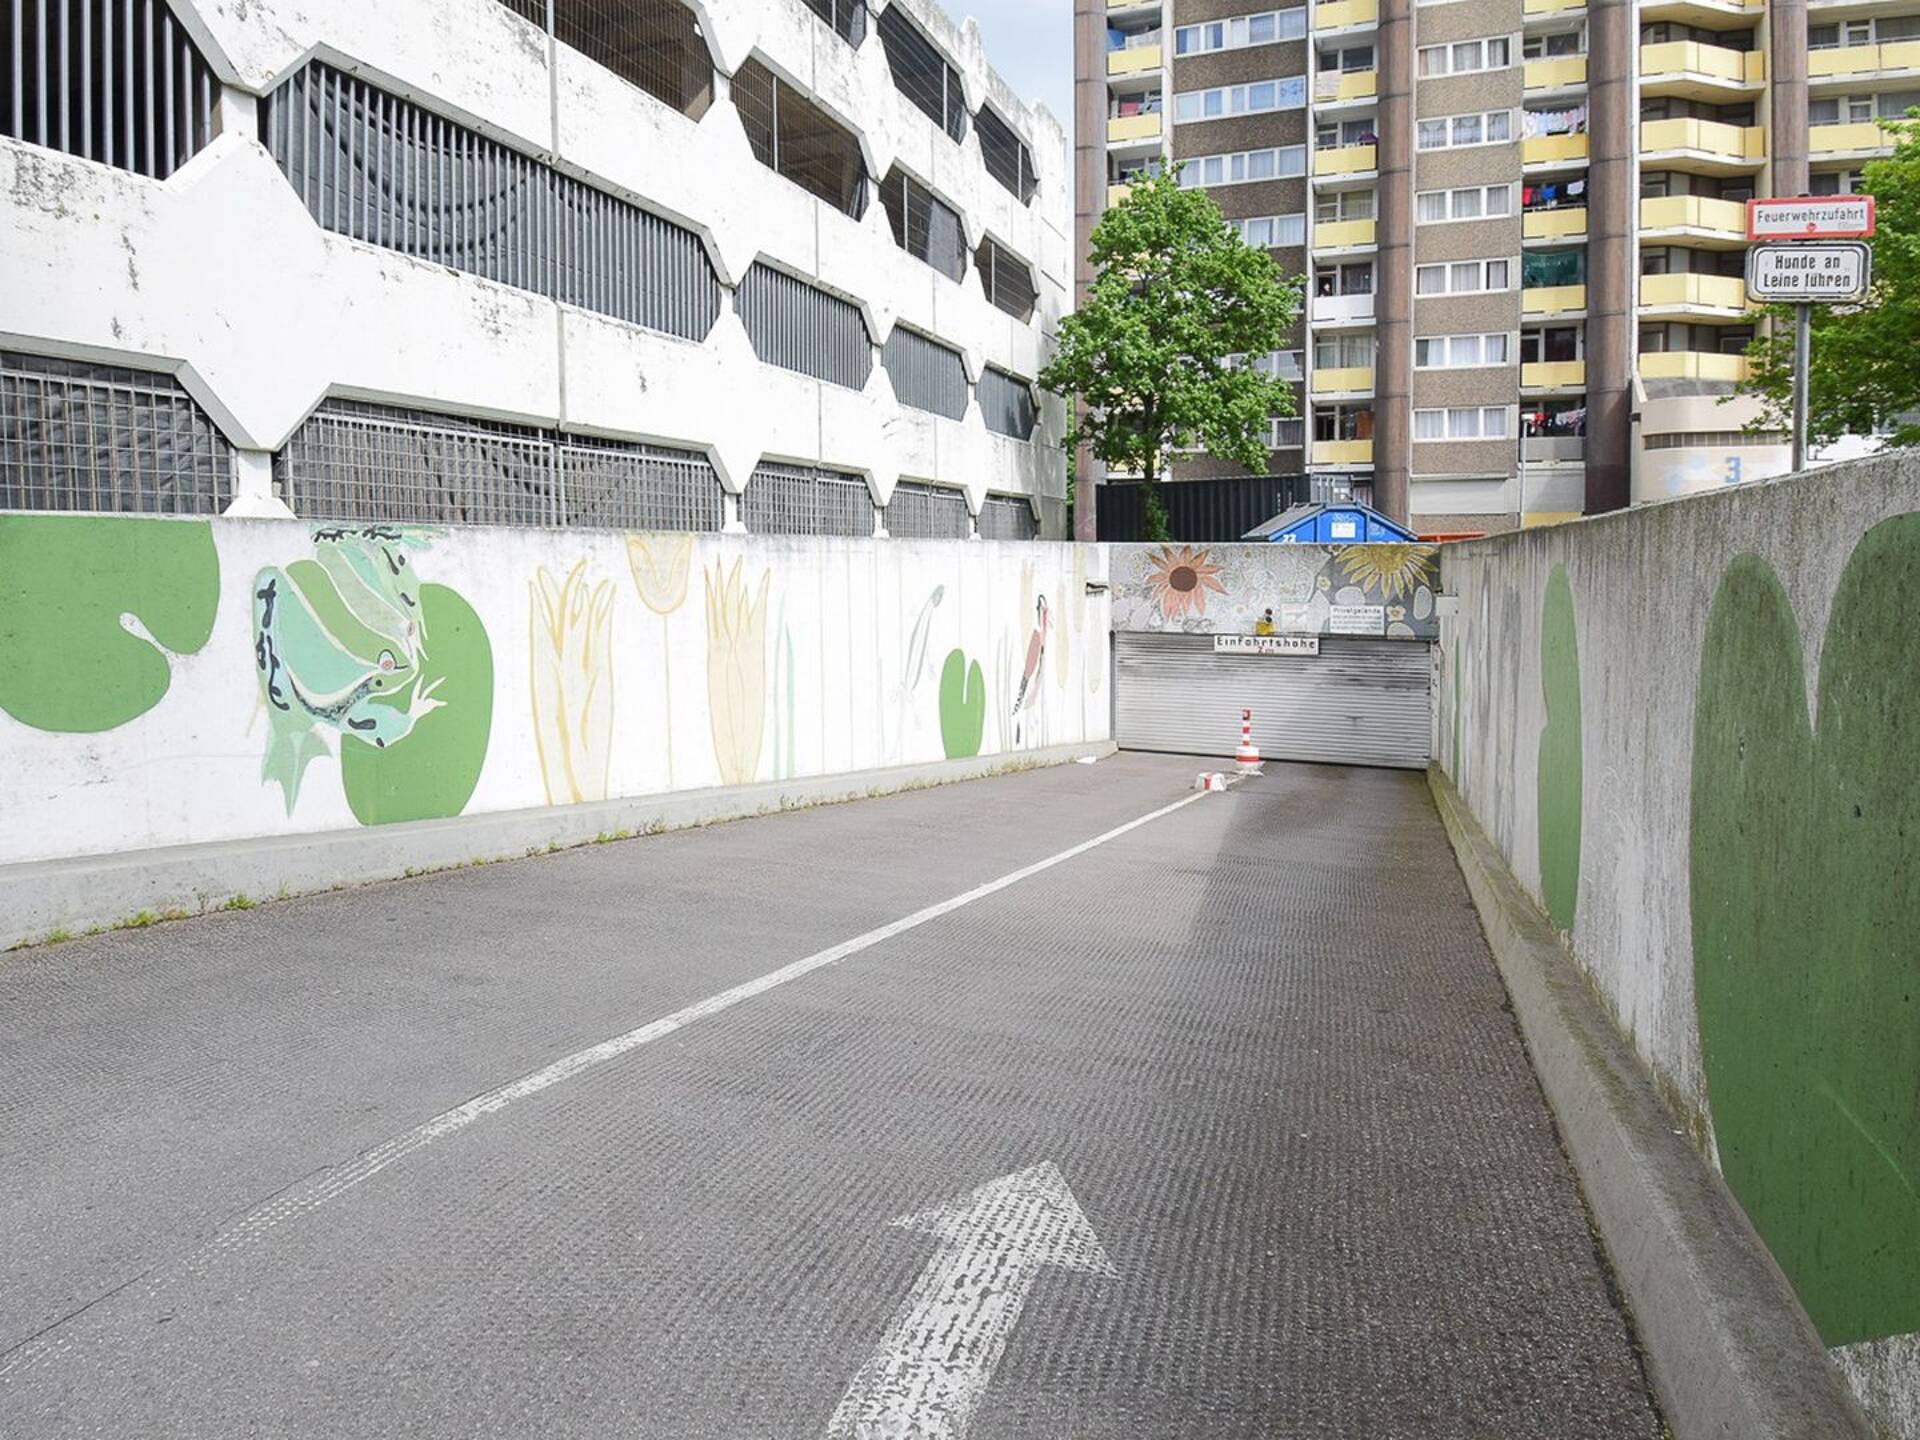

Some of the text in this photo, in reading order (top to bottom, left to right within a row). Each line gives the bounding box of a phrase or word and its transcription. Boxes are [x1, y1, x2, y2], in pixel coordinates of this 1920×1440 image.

[1757, 208, 1865, 223] Feuerwehrzufahrt
[1775, 255, 1840, 270] Hunde an
[1763, 272, 1850, 288] Leine führen
[1725, 456, 1741, 483] 3
